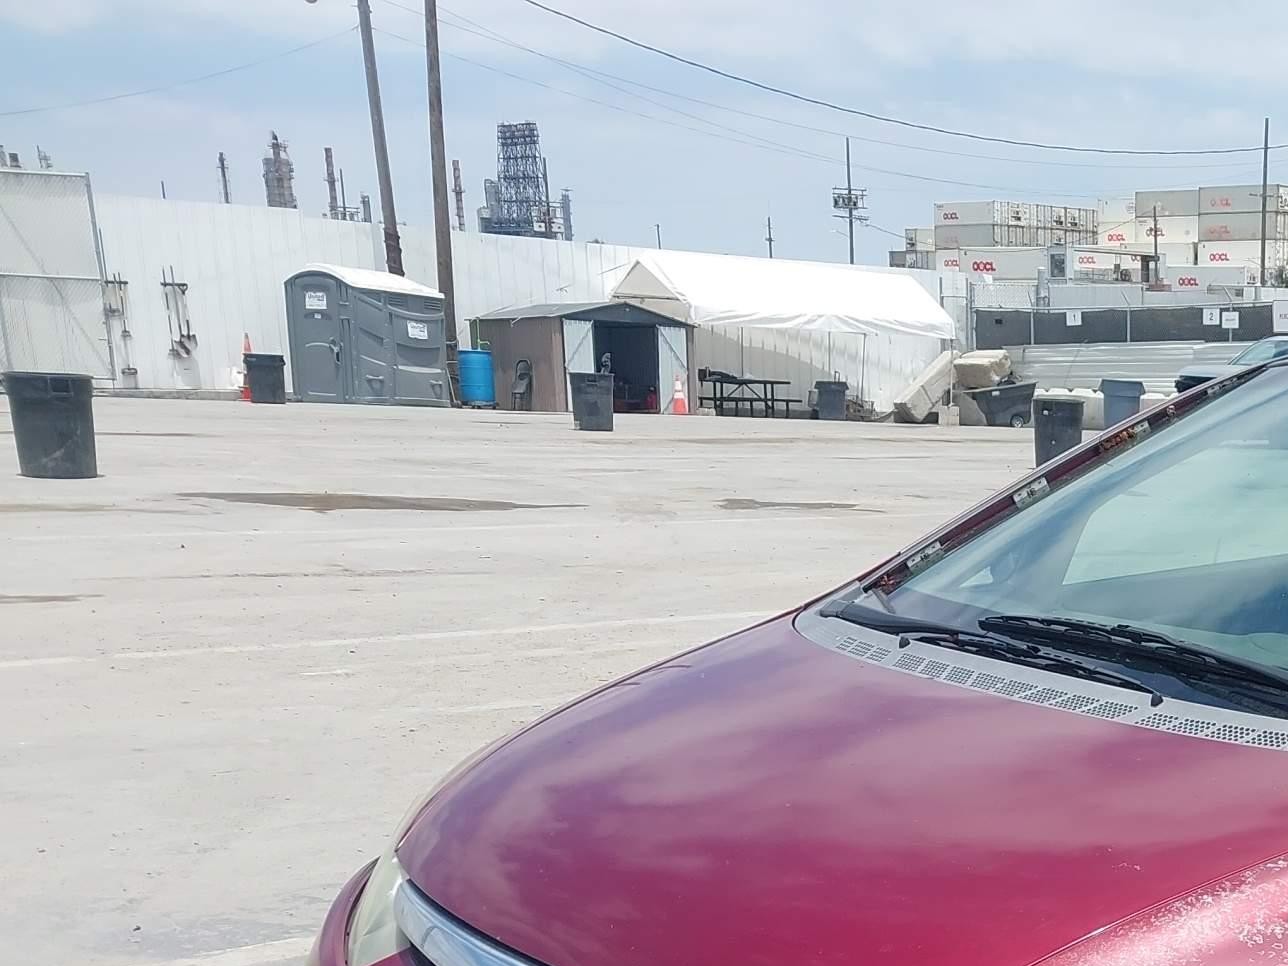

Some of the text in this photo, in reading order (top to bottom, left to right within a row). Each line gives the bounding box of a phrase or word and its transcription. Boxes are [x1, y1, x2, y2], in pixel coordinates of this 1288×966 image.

[1078, 256, 1096, 264] OOCL
[1209, 253, 1230, 261] OOCL
[972, 261, 996, 272] OOCL
[1178, 278, 1199, 286] OOCL
[1209, 312, 1214, 321] 2
